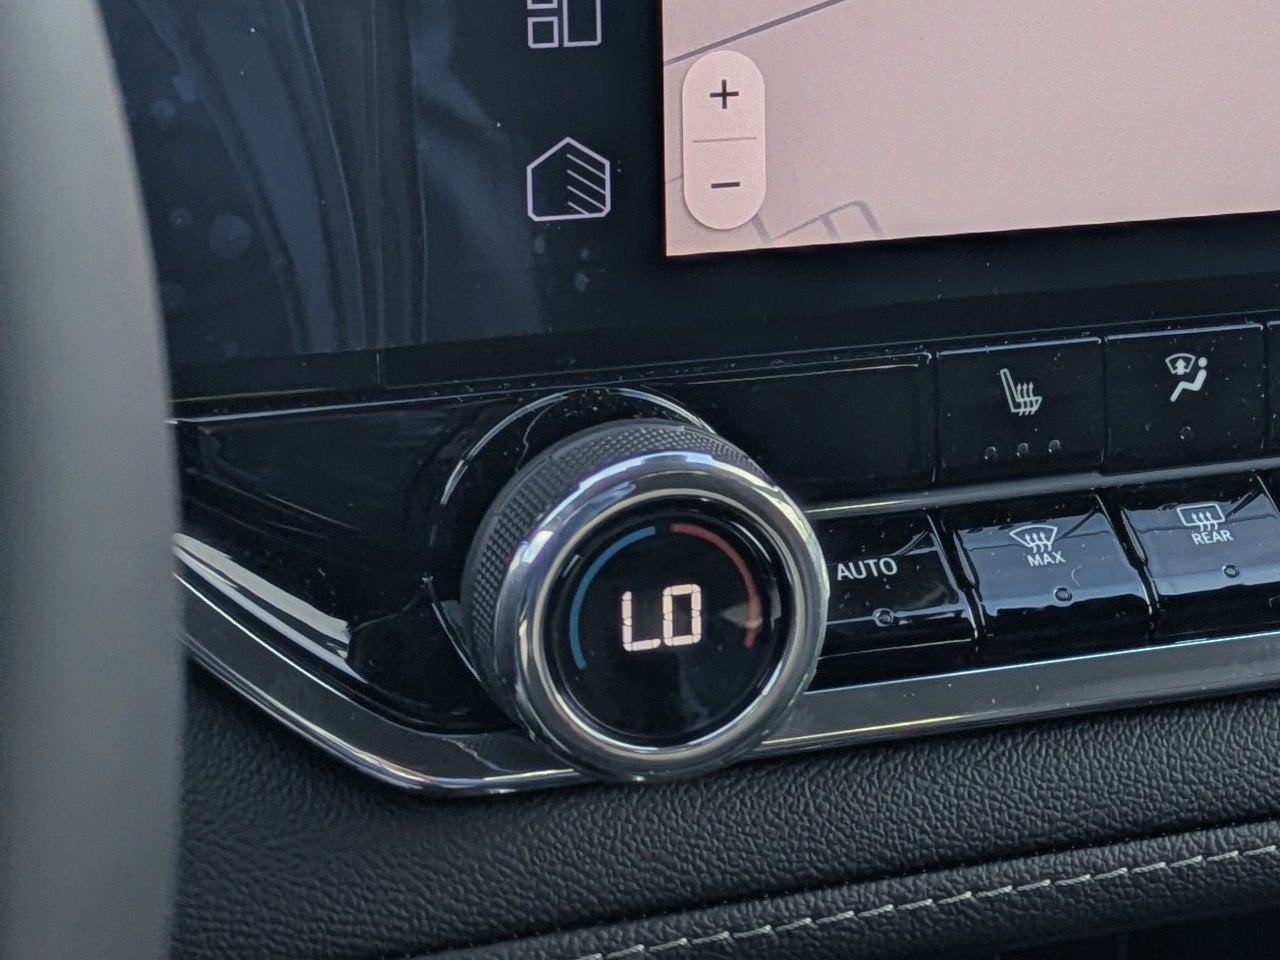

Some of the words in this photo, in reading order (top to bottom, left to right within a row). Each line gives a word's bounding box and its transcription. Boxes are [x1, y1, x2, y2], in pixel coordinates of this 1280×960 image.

[1190, 528, 1235, 546] REAR
[1027, 550, 1066, 568] MAX
[836, 557, 898, 582] AUTO
